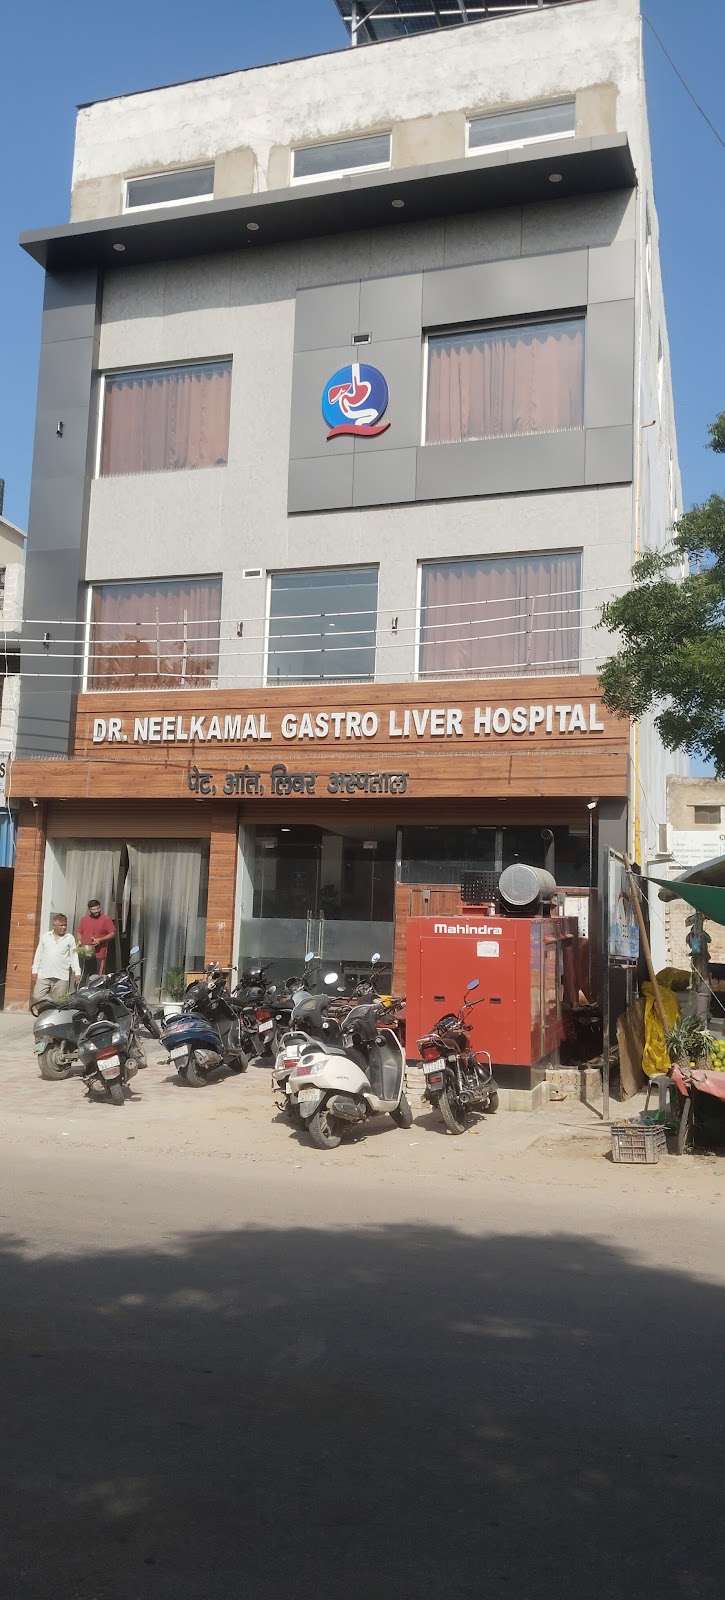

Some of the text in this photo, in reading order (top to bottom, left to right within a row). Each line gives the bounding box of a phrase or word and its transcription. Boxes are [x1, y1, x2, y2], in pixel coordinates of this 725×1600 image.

[92, 703, 604, 743] DR. NEELKAMAL GASTRO LIVER HOSPITAL
[187, 765, 216, 796] पेट,
[222, 764, 264, 796] आंत,
[326, 771, 409, 795] अस्पताल
[434, 923, 502, 935] Mahindra
